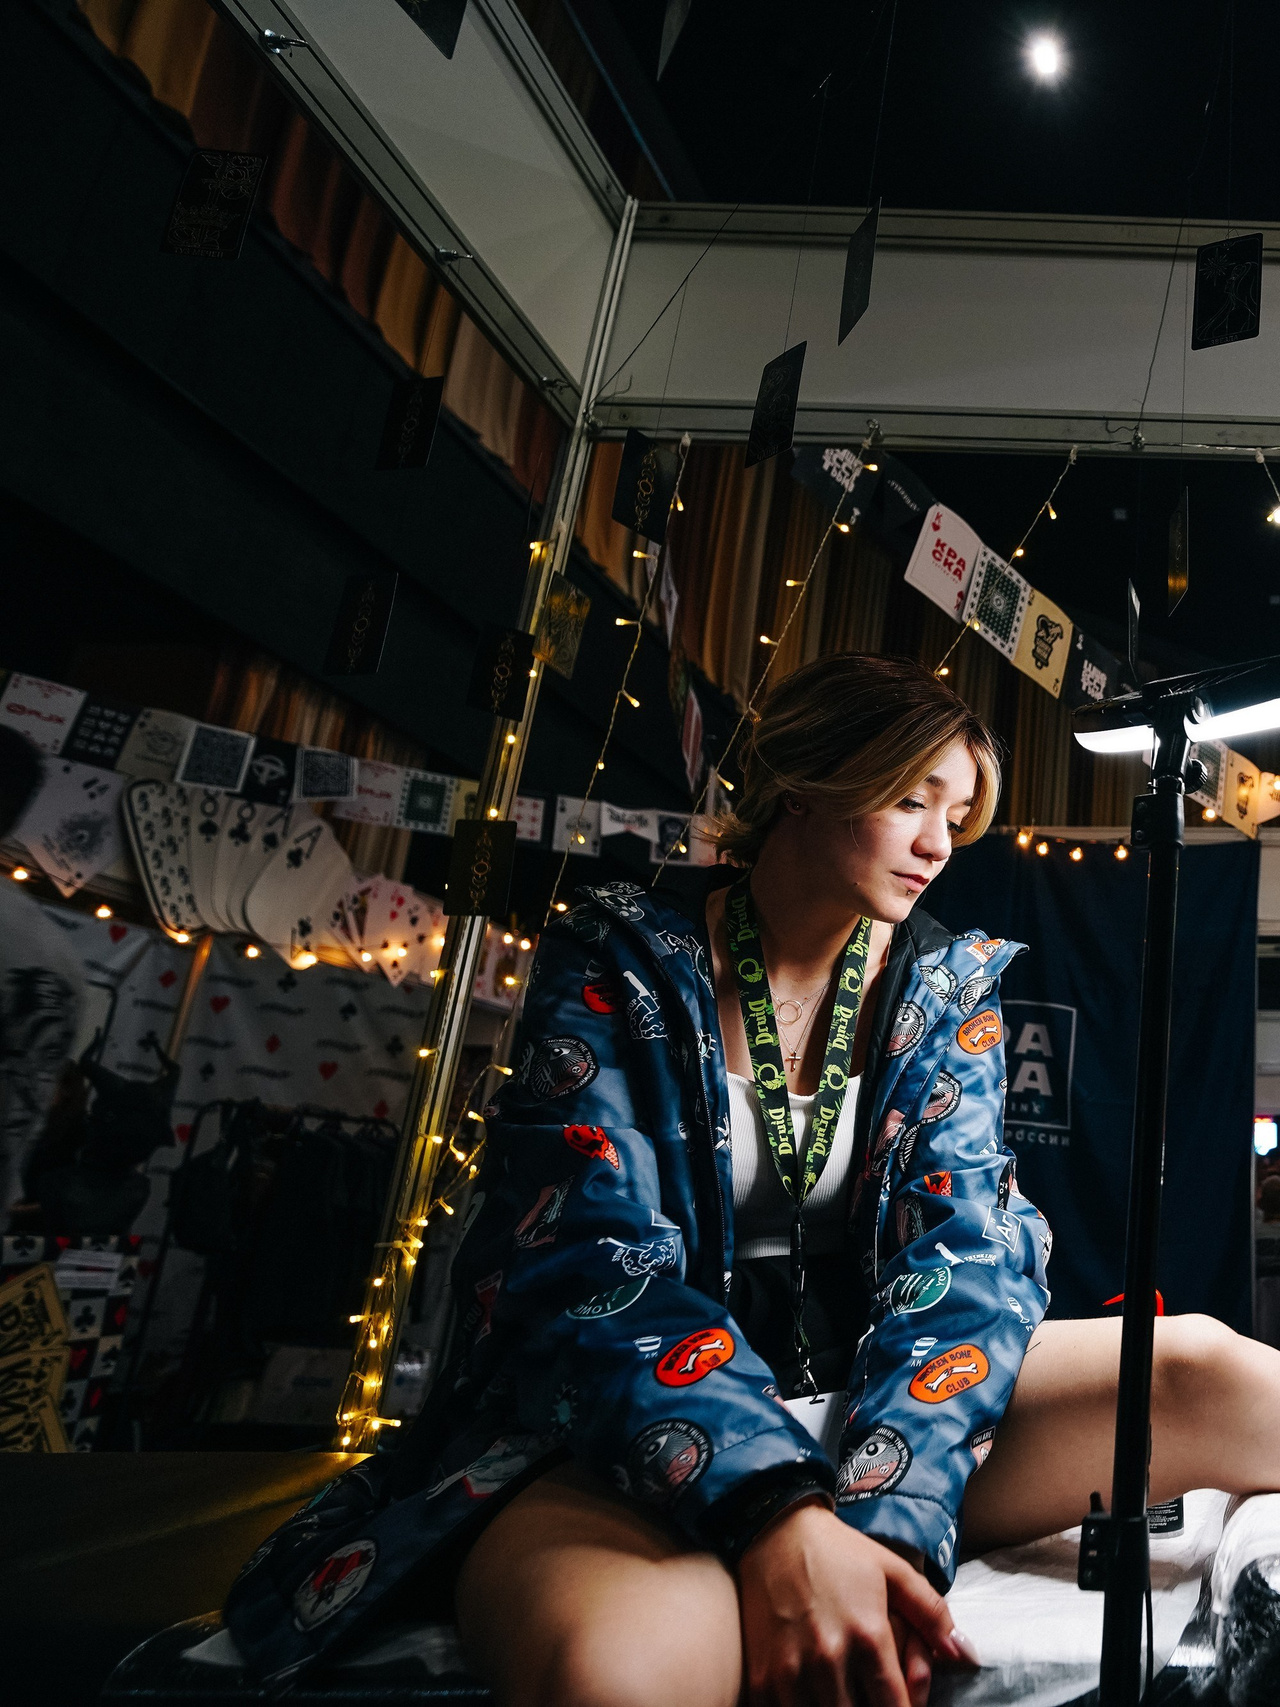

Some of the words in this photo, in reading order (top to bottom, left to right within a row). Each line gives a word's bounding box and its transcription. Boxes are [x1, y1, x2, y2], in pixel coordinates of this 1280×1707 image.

[962, 1017, 984, 1037] BROKEN
[981, 1035, 996, 1048] CLUB
[996, 1214, 1013, 1242] Ar
[910, 1359, 922, 1368] AM
[917, 1357, 949, 1383] BROKEN
[950, 1349, 973, 1362] BONE
[945, 1376, 971, 1395] CLUB
[972, 1433, 983, 1446] YOU
[982, 1429, 994, 1441] ARE
